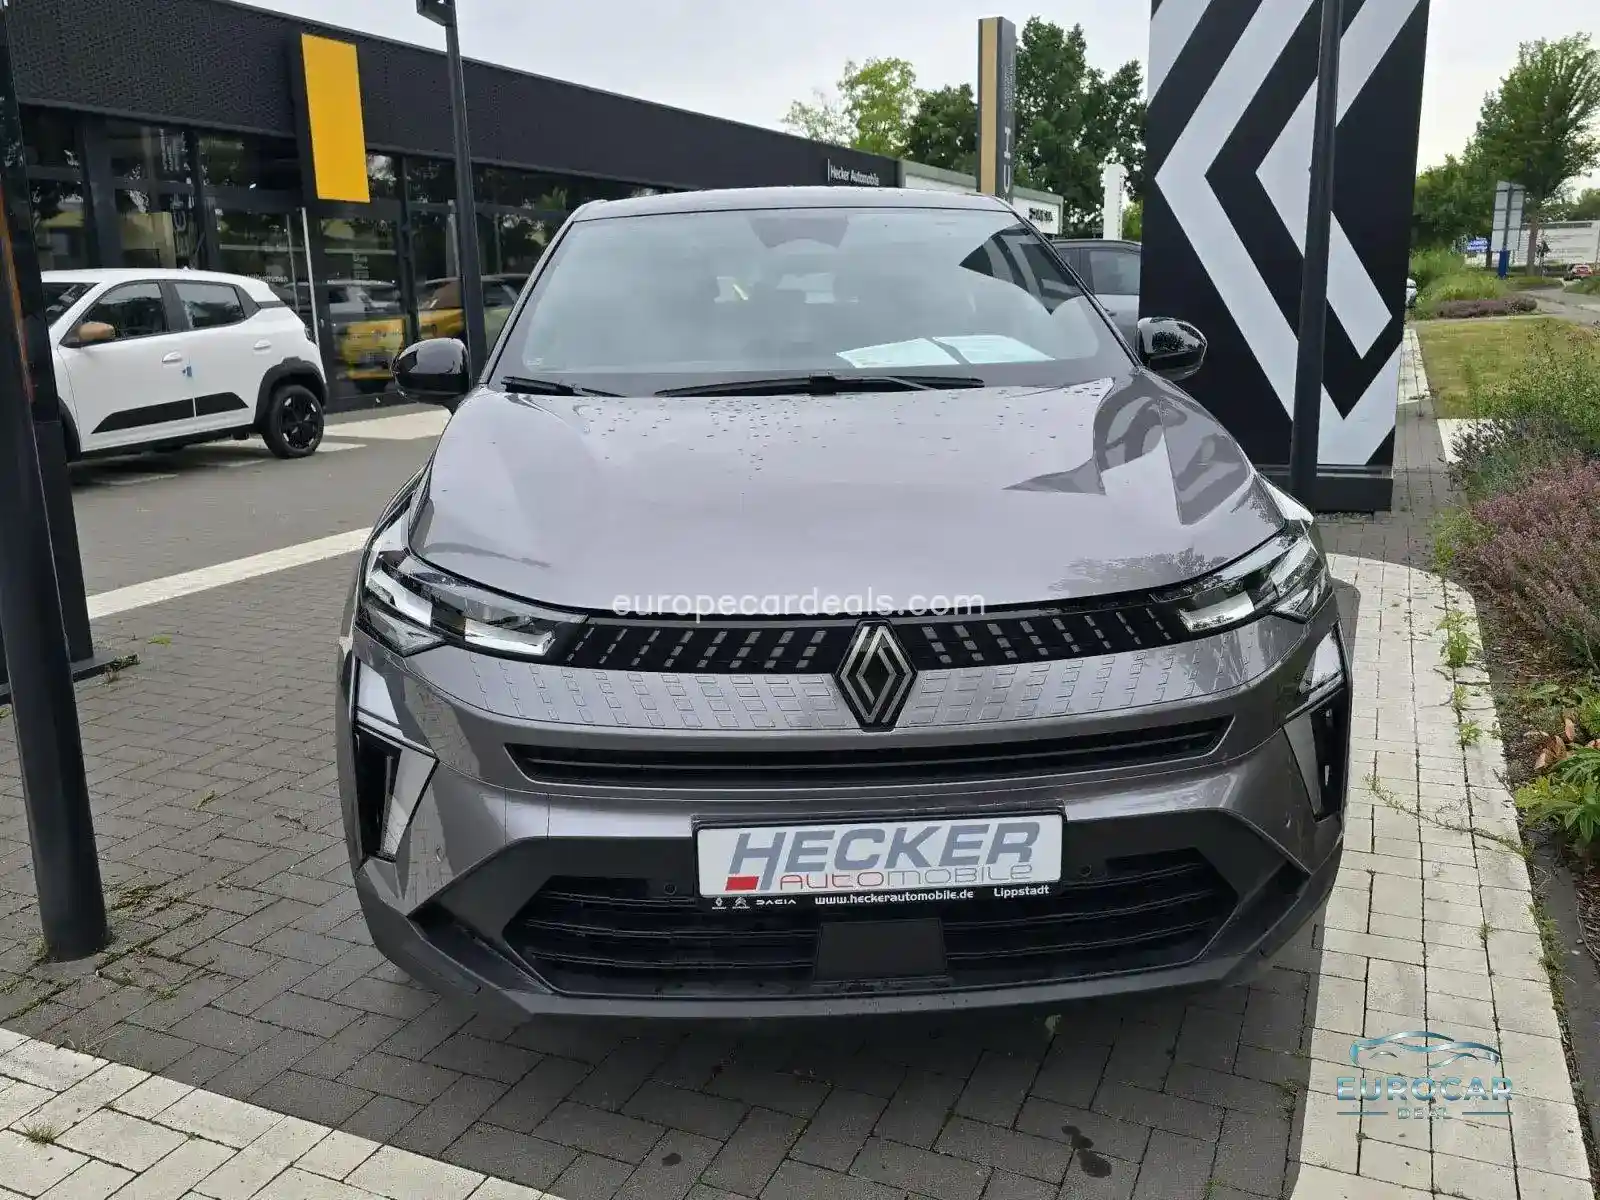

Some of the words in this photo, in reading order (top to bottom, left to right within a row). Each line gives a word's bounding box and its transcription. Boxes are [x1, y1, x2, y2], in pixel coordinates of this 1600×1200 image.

[830, 164, 850, 181] Hecker
[728, 821, 1040, 890] HECKER
[814, 890, 974, 906] www.heckerautomobile.de
[993, 885, 1050, 900] Lippstadt
